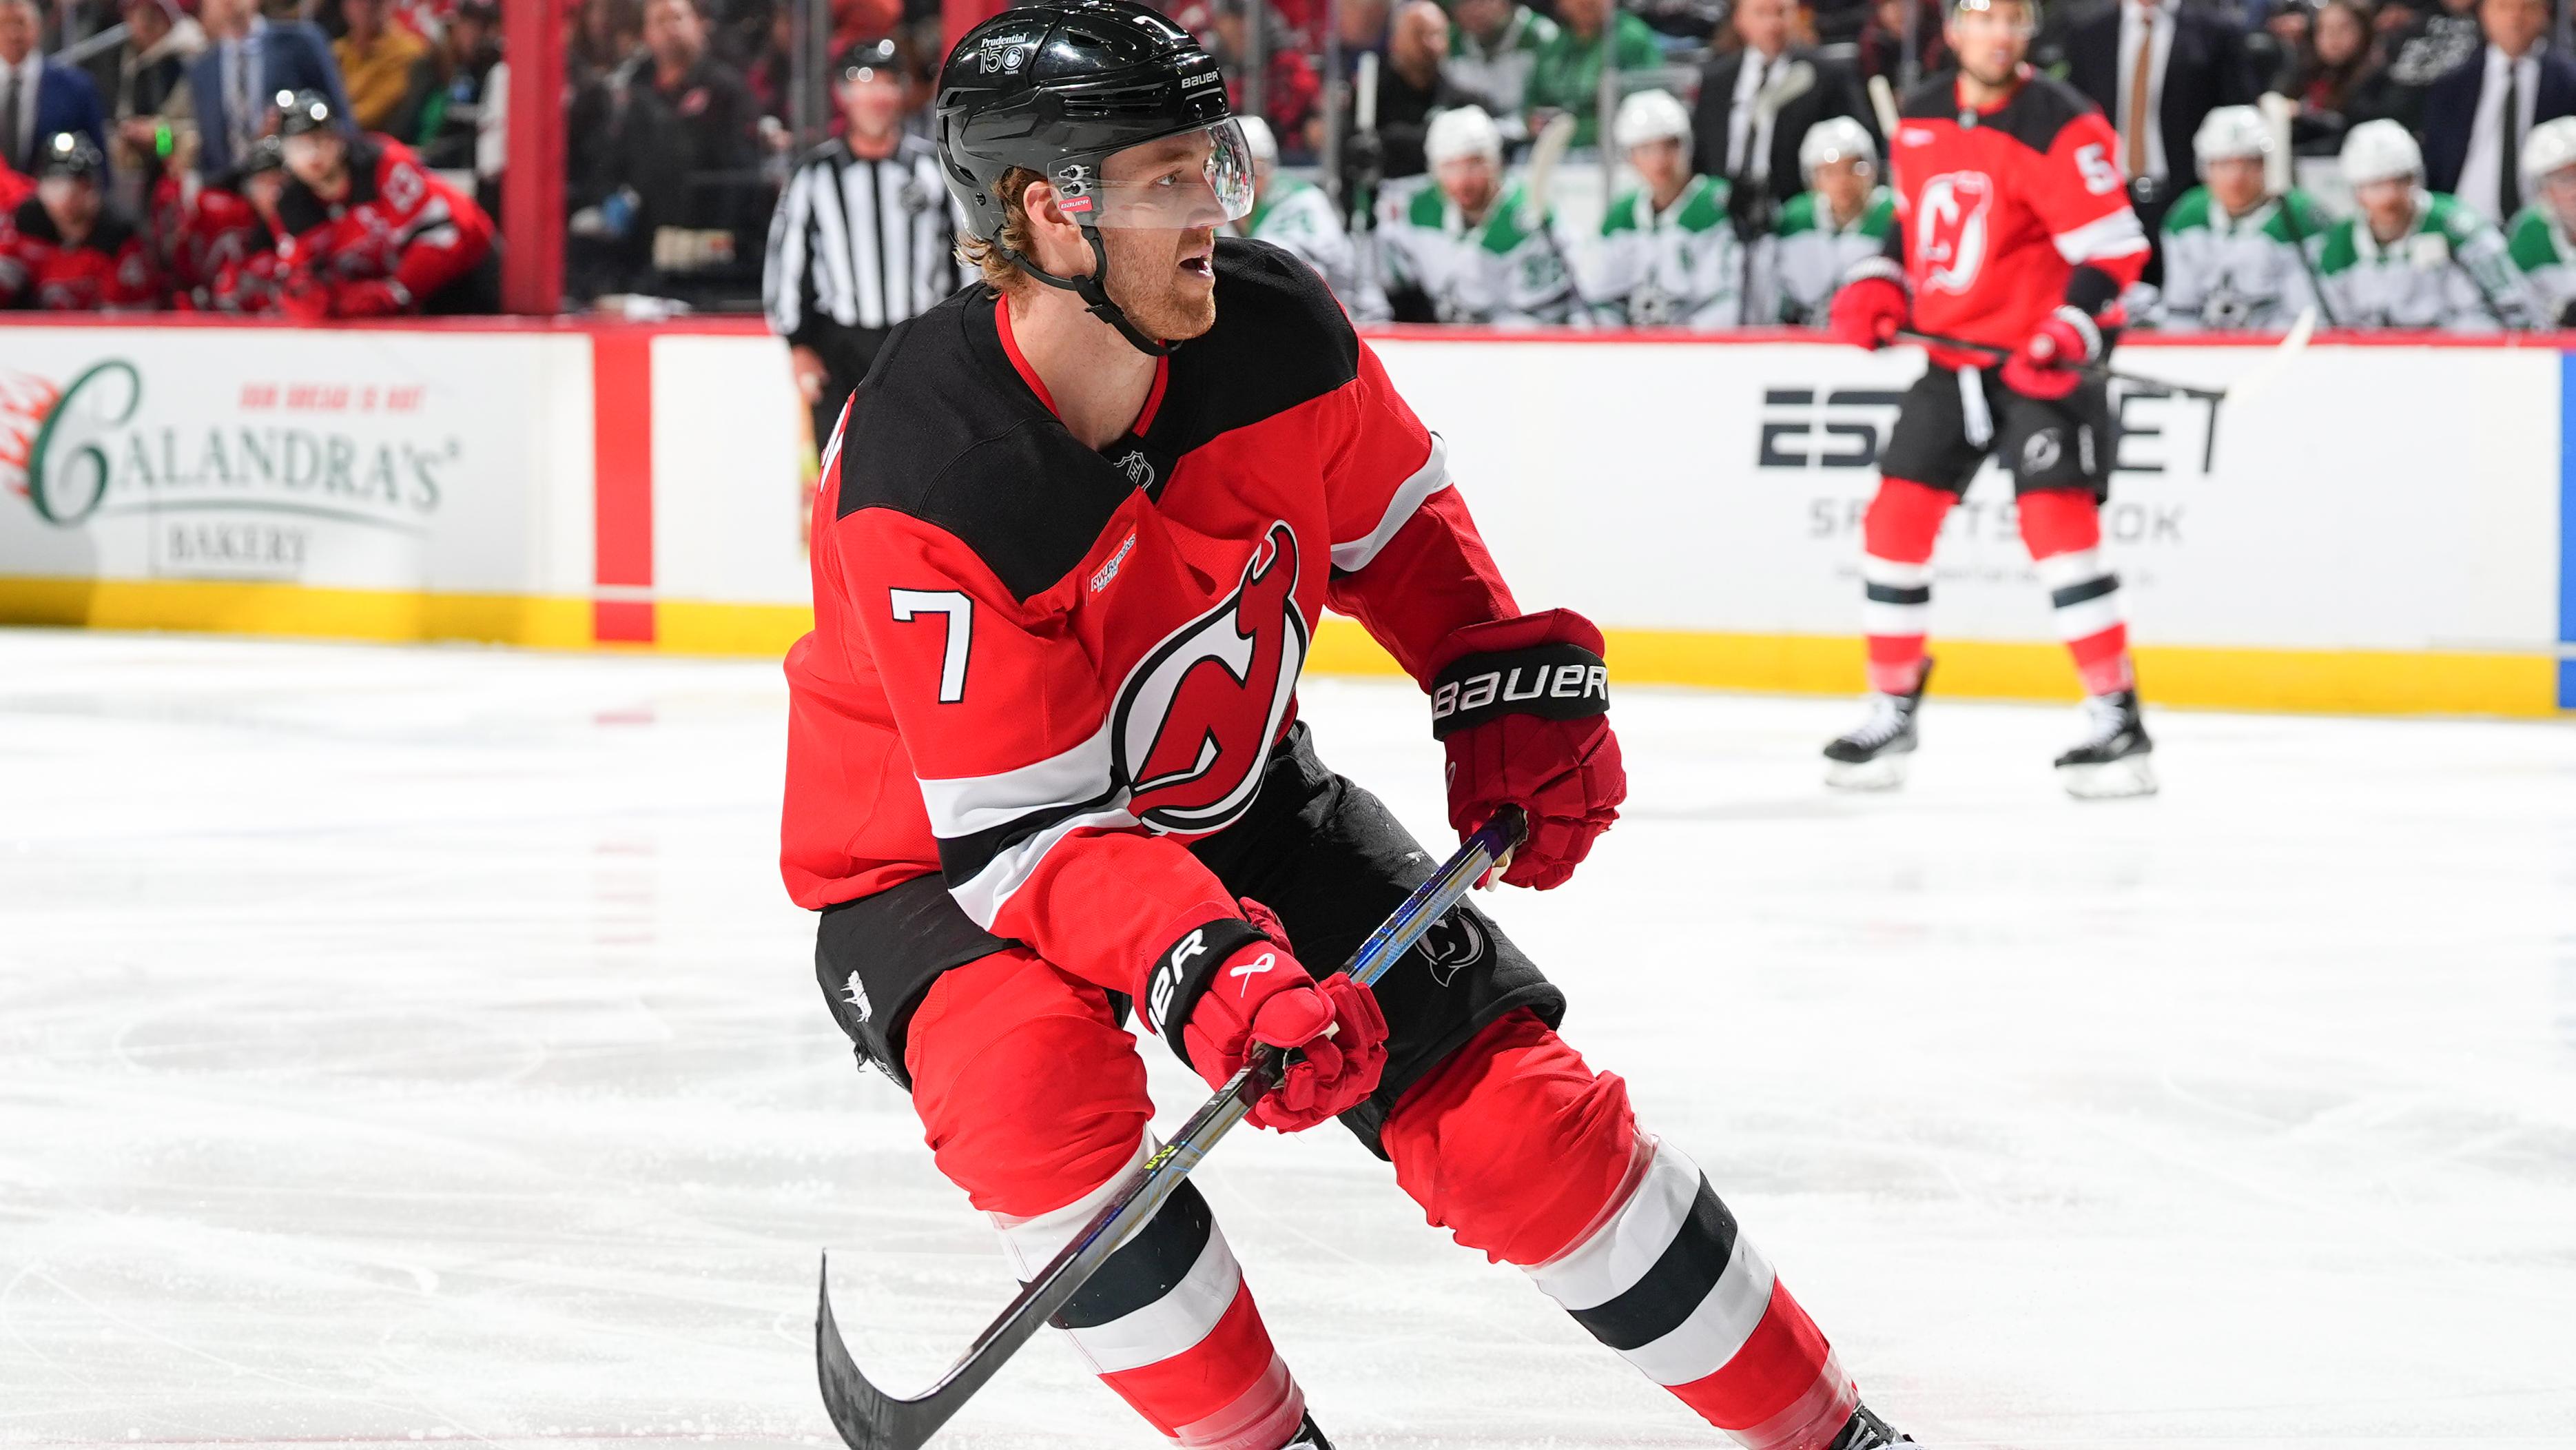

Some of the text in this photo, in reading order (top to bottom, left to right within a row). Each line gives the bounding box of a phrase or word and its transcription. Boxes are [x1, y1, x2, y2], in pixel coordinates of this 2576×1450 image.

[981, 32, 1027, 48] Prudential
[2074, 142, 2115, 195] 5
[169, 522, 308, 562] BAKERY
[889, 586, 975, 704] 7
[1432, 664, 1607, 719] BAUER
